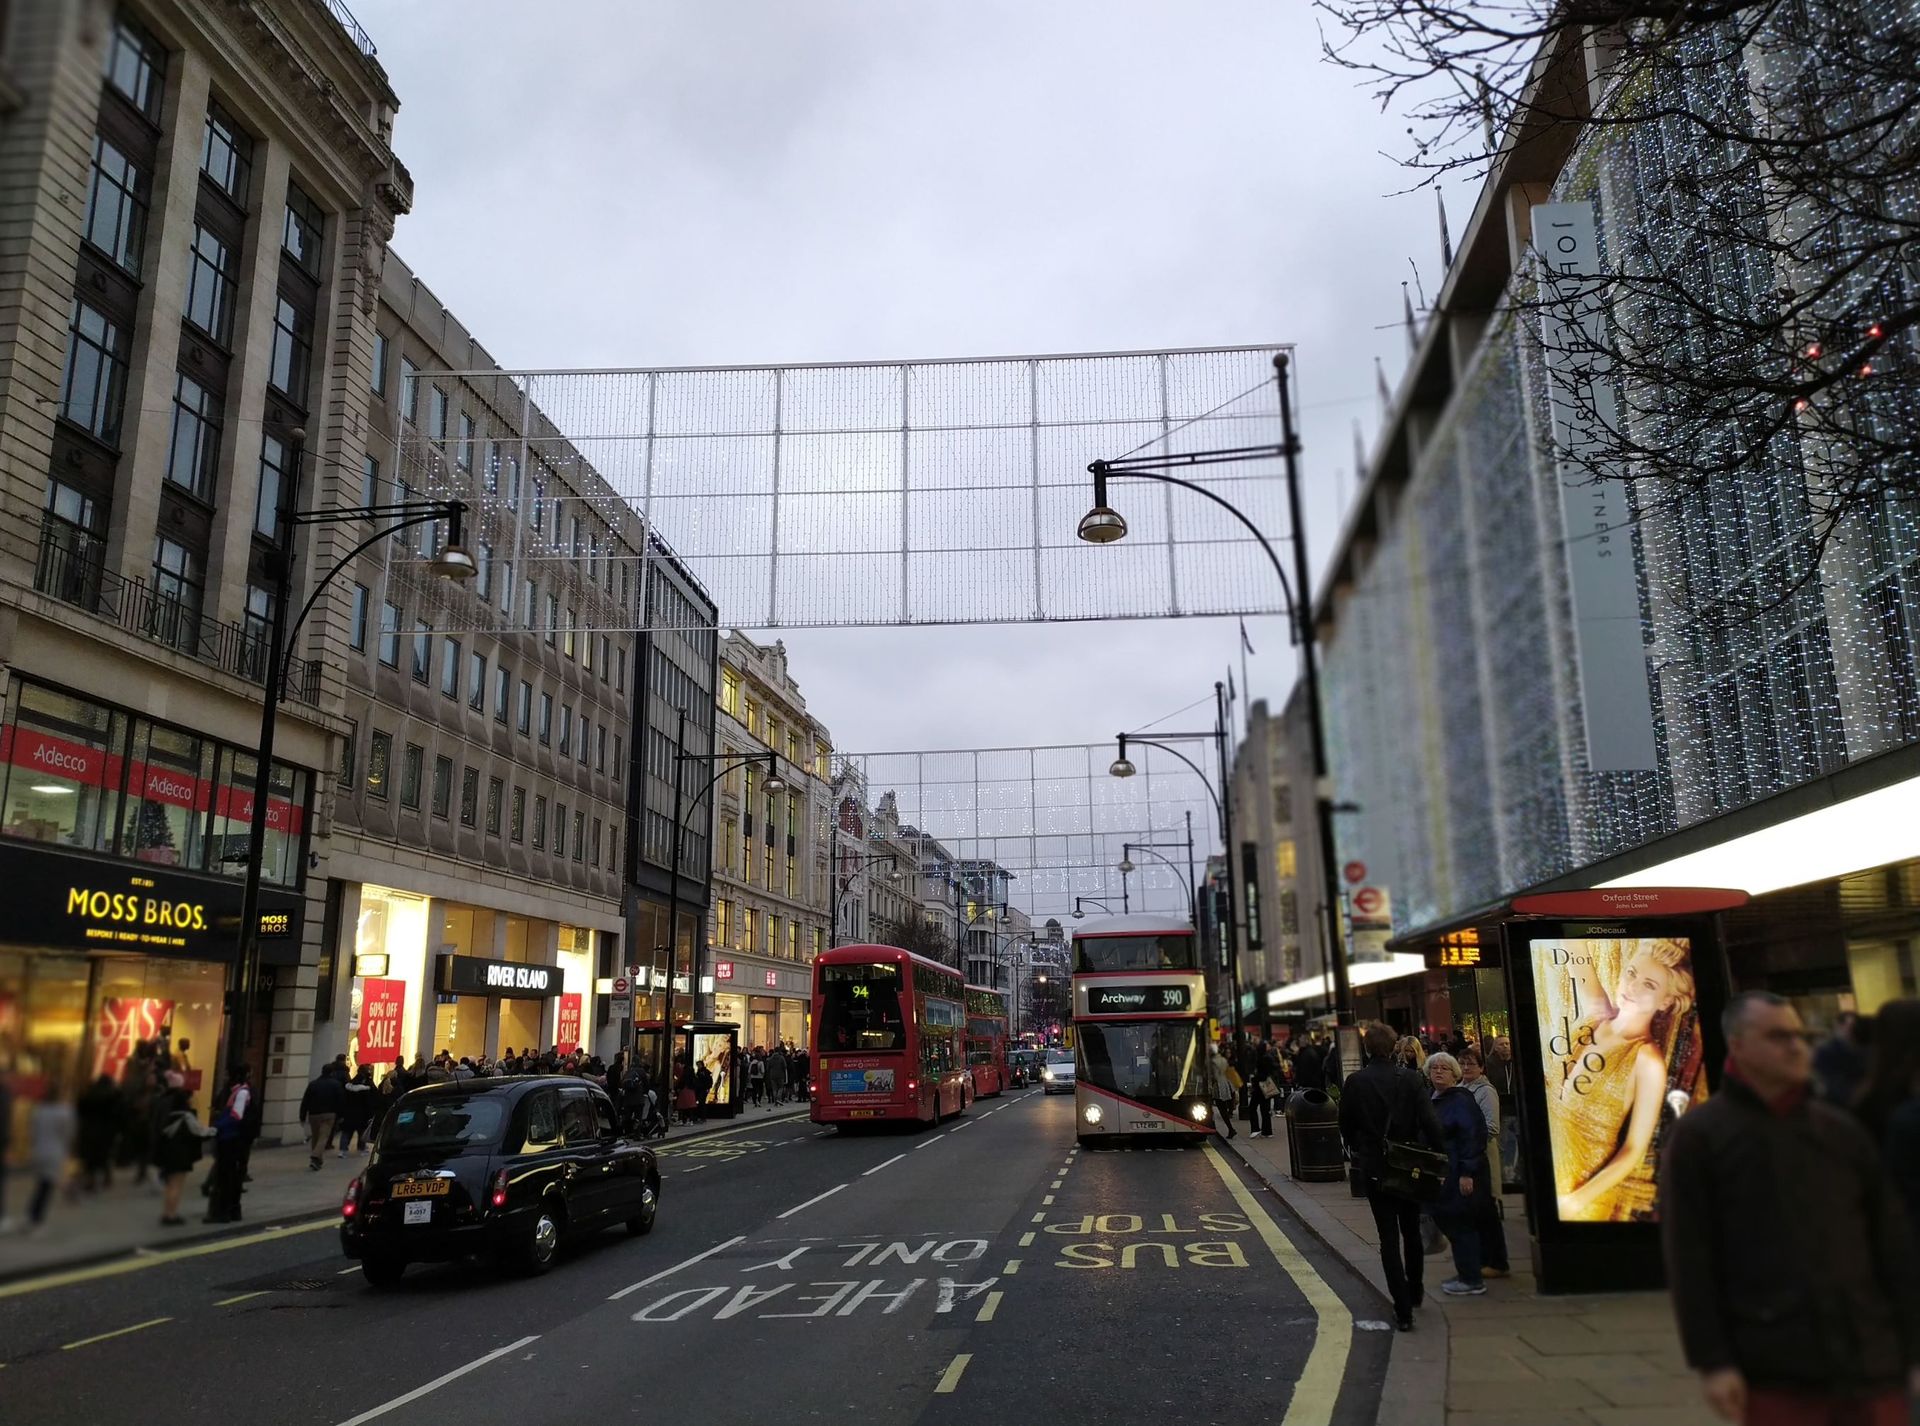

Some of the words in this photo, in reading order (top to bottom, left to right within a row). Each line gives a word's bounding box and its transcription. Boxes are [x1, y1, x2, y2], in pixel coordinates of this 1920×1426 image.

[33, 743, 86, 773] Adecco
[149, 775, 192, 800] Adecco
[1602, 894, 1631, 902] Oxford
[1633, 893, 1659, 901] Street
[67, 887, 139, 922] MOSS
[144, 898, 208, 931] BROS.
[261, 915, 288, 924] MOSS
[261, 923, 289, 933] BROS.
[86, 928, 113, 939] BESPOKE
[172, 937, 185, 946] HIRE
[1586, 926, 1627, 935] JCDecaux
[1552, 948, 1593, 966] Dior
[487, 965, 514, 987] RIVER
[516, 968, 548, 989] ISLAND
[853, 985, 869, 998] 94
[1101, 993, 1145, 1005] Archway
[1163, 990, 1182, 1006] 390
[369, 1002, 384, 1017] 60%
[386, 1003, 398, 1017] OFF
[366, 1020, 396, 1048] SALE
[561, 1022, 577, 1043] SALE
[397, 1184, 423, 1195] LR65
[426, 1182, 445, 1193] VDP
[1044, 1213, 1251, 1234] STOP
[740, 1239, 989, 1271] ONLY
[1055, 1242, 1249, 1269] BUS
[631, 1277, 999, 1321] AHEAD
